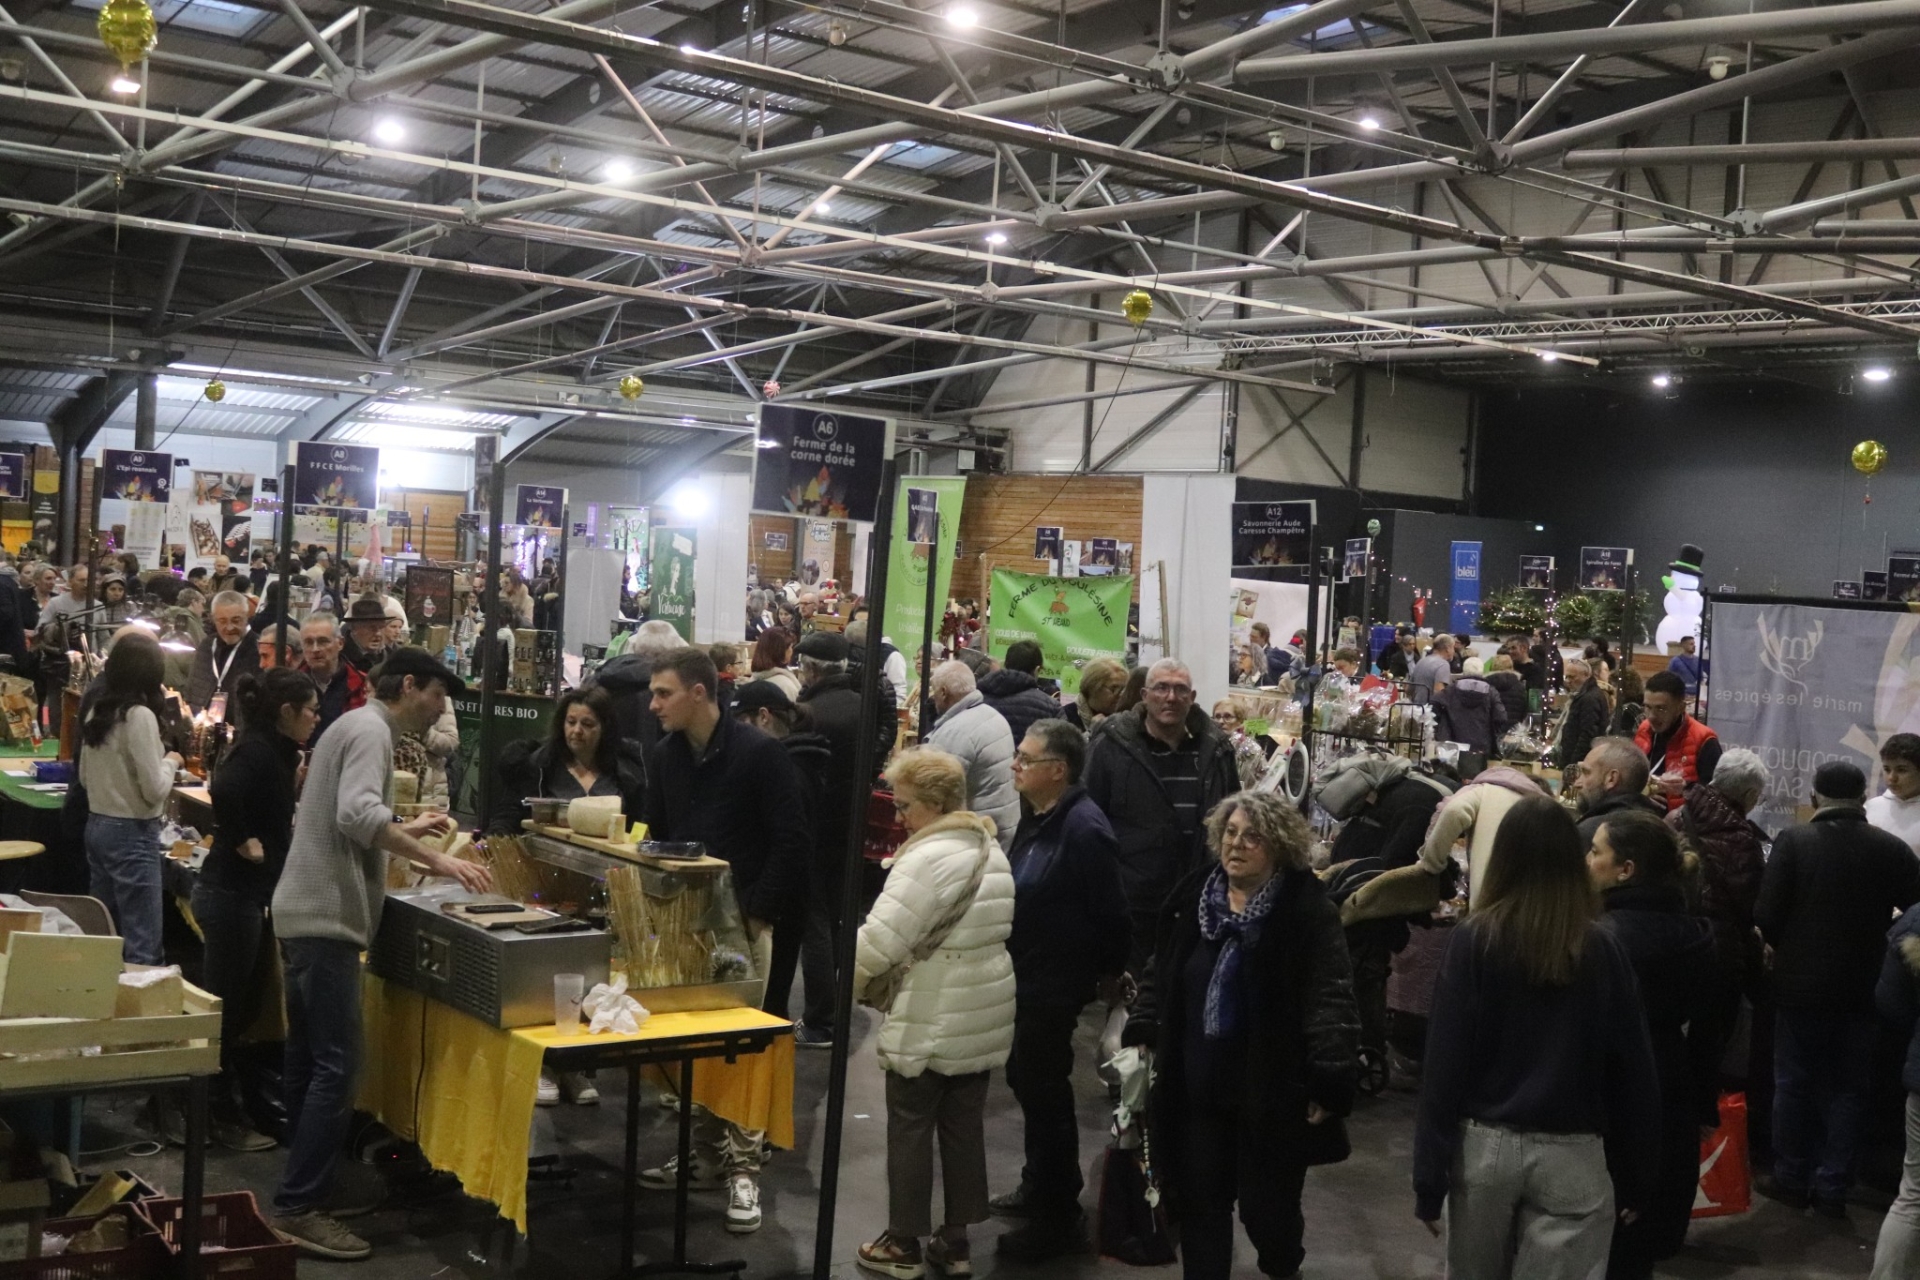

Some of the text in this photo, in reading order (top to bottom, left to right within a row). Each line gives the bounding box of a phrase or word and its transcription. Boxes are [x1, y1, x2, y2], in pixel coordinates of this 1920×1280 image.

[817, 420, 833, 434] A6
[793, 436, 855, 454] Ferme de la
[790, 450, 856, 466] corne dorée
[335, 463, 364, 473] Morilles
[1267, 507, 1282, 516] A12
[1239, 526, 1306, 535] Caresse Champêtre
[1457, 565, 1476, 577] bleu
[1008, 582, 1039, 618] FERME
[1041, 578, 1058, 587] DU
[516, 708, 538, 719] BIO
